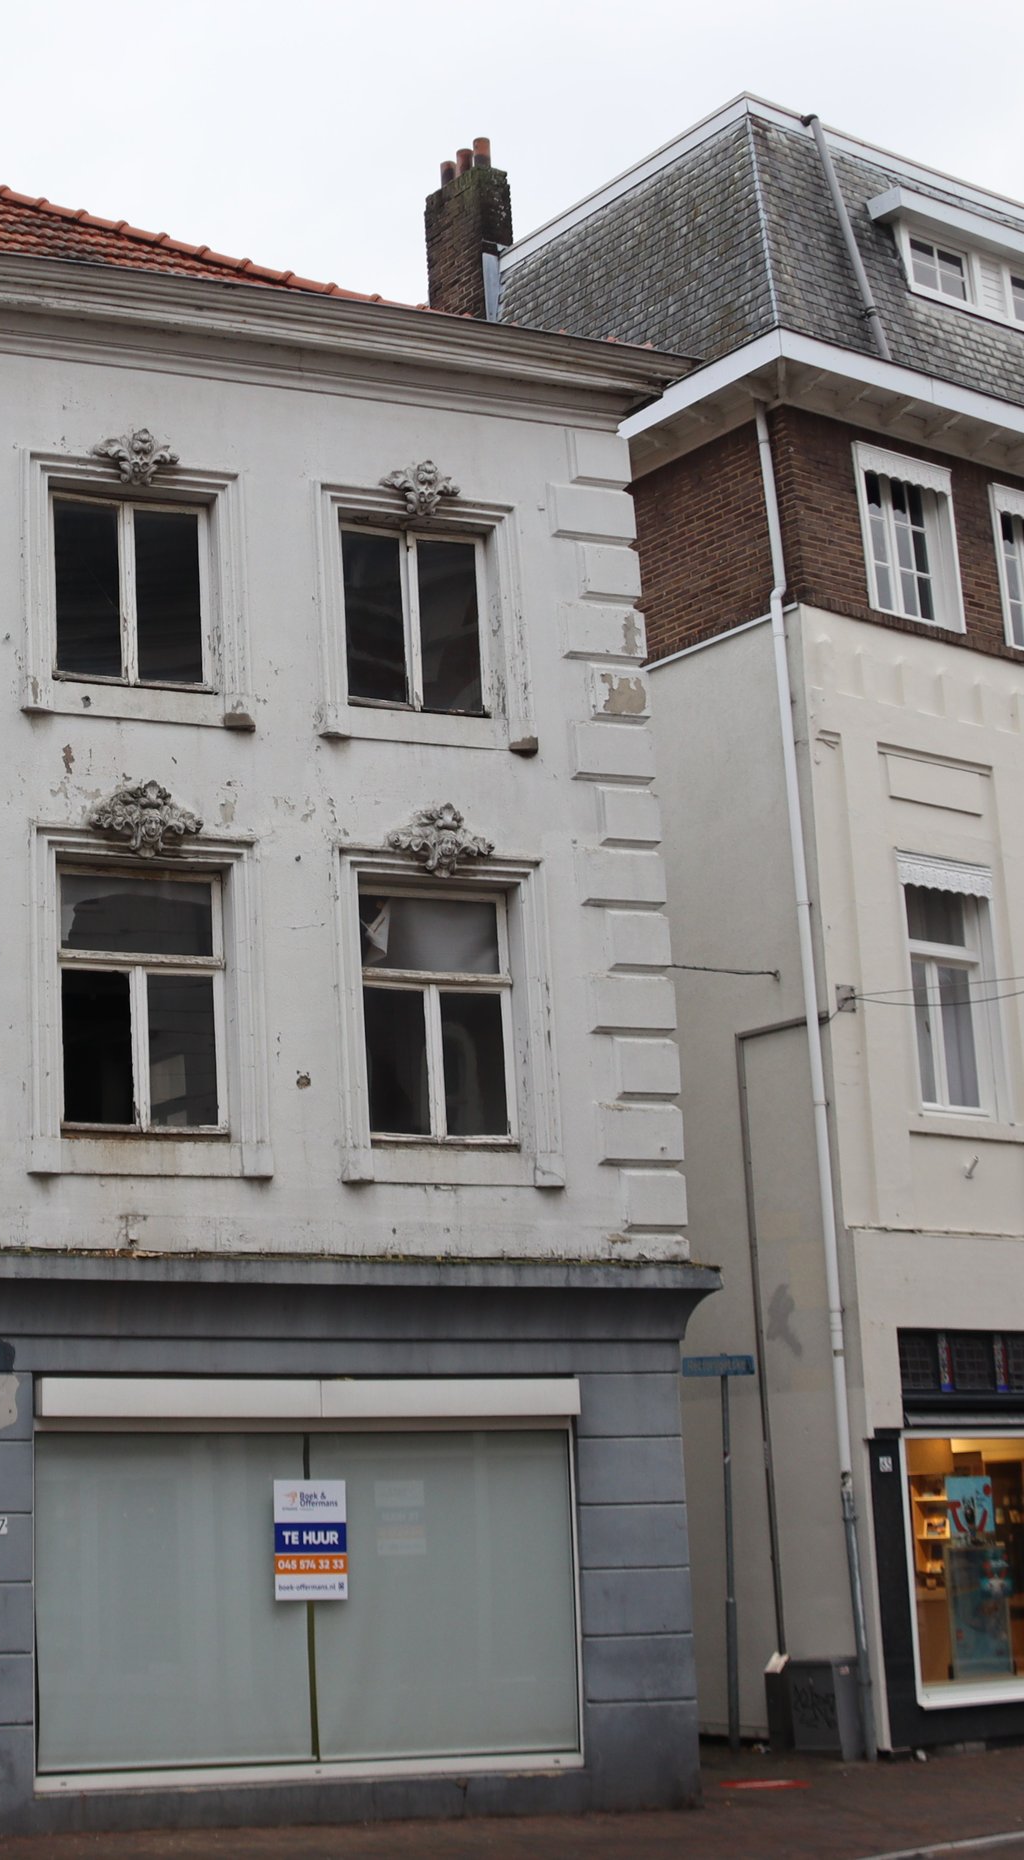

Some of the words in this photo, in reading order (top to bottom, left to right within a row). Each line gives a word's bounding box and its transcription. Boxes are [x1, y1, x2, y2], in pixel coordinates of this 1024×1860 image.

[299, 1491, 317, 1500] Boek
[320, 1491, 327, 1500] &
[299, 1499, 338, 1507] Offermans
[282, 1531, 300, 1545] TE
[303, 1531, 339, 1545] HUUR
[278, 1559, 297, 1570] 045
[299, 1559, 316, 1570] 574
[319, 1559, 330, 1570] 32
[333, 1559, 344, 1570] 33
